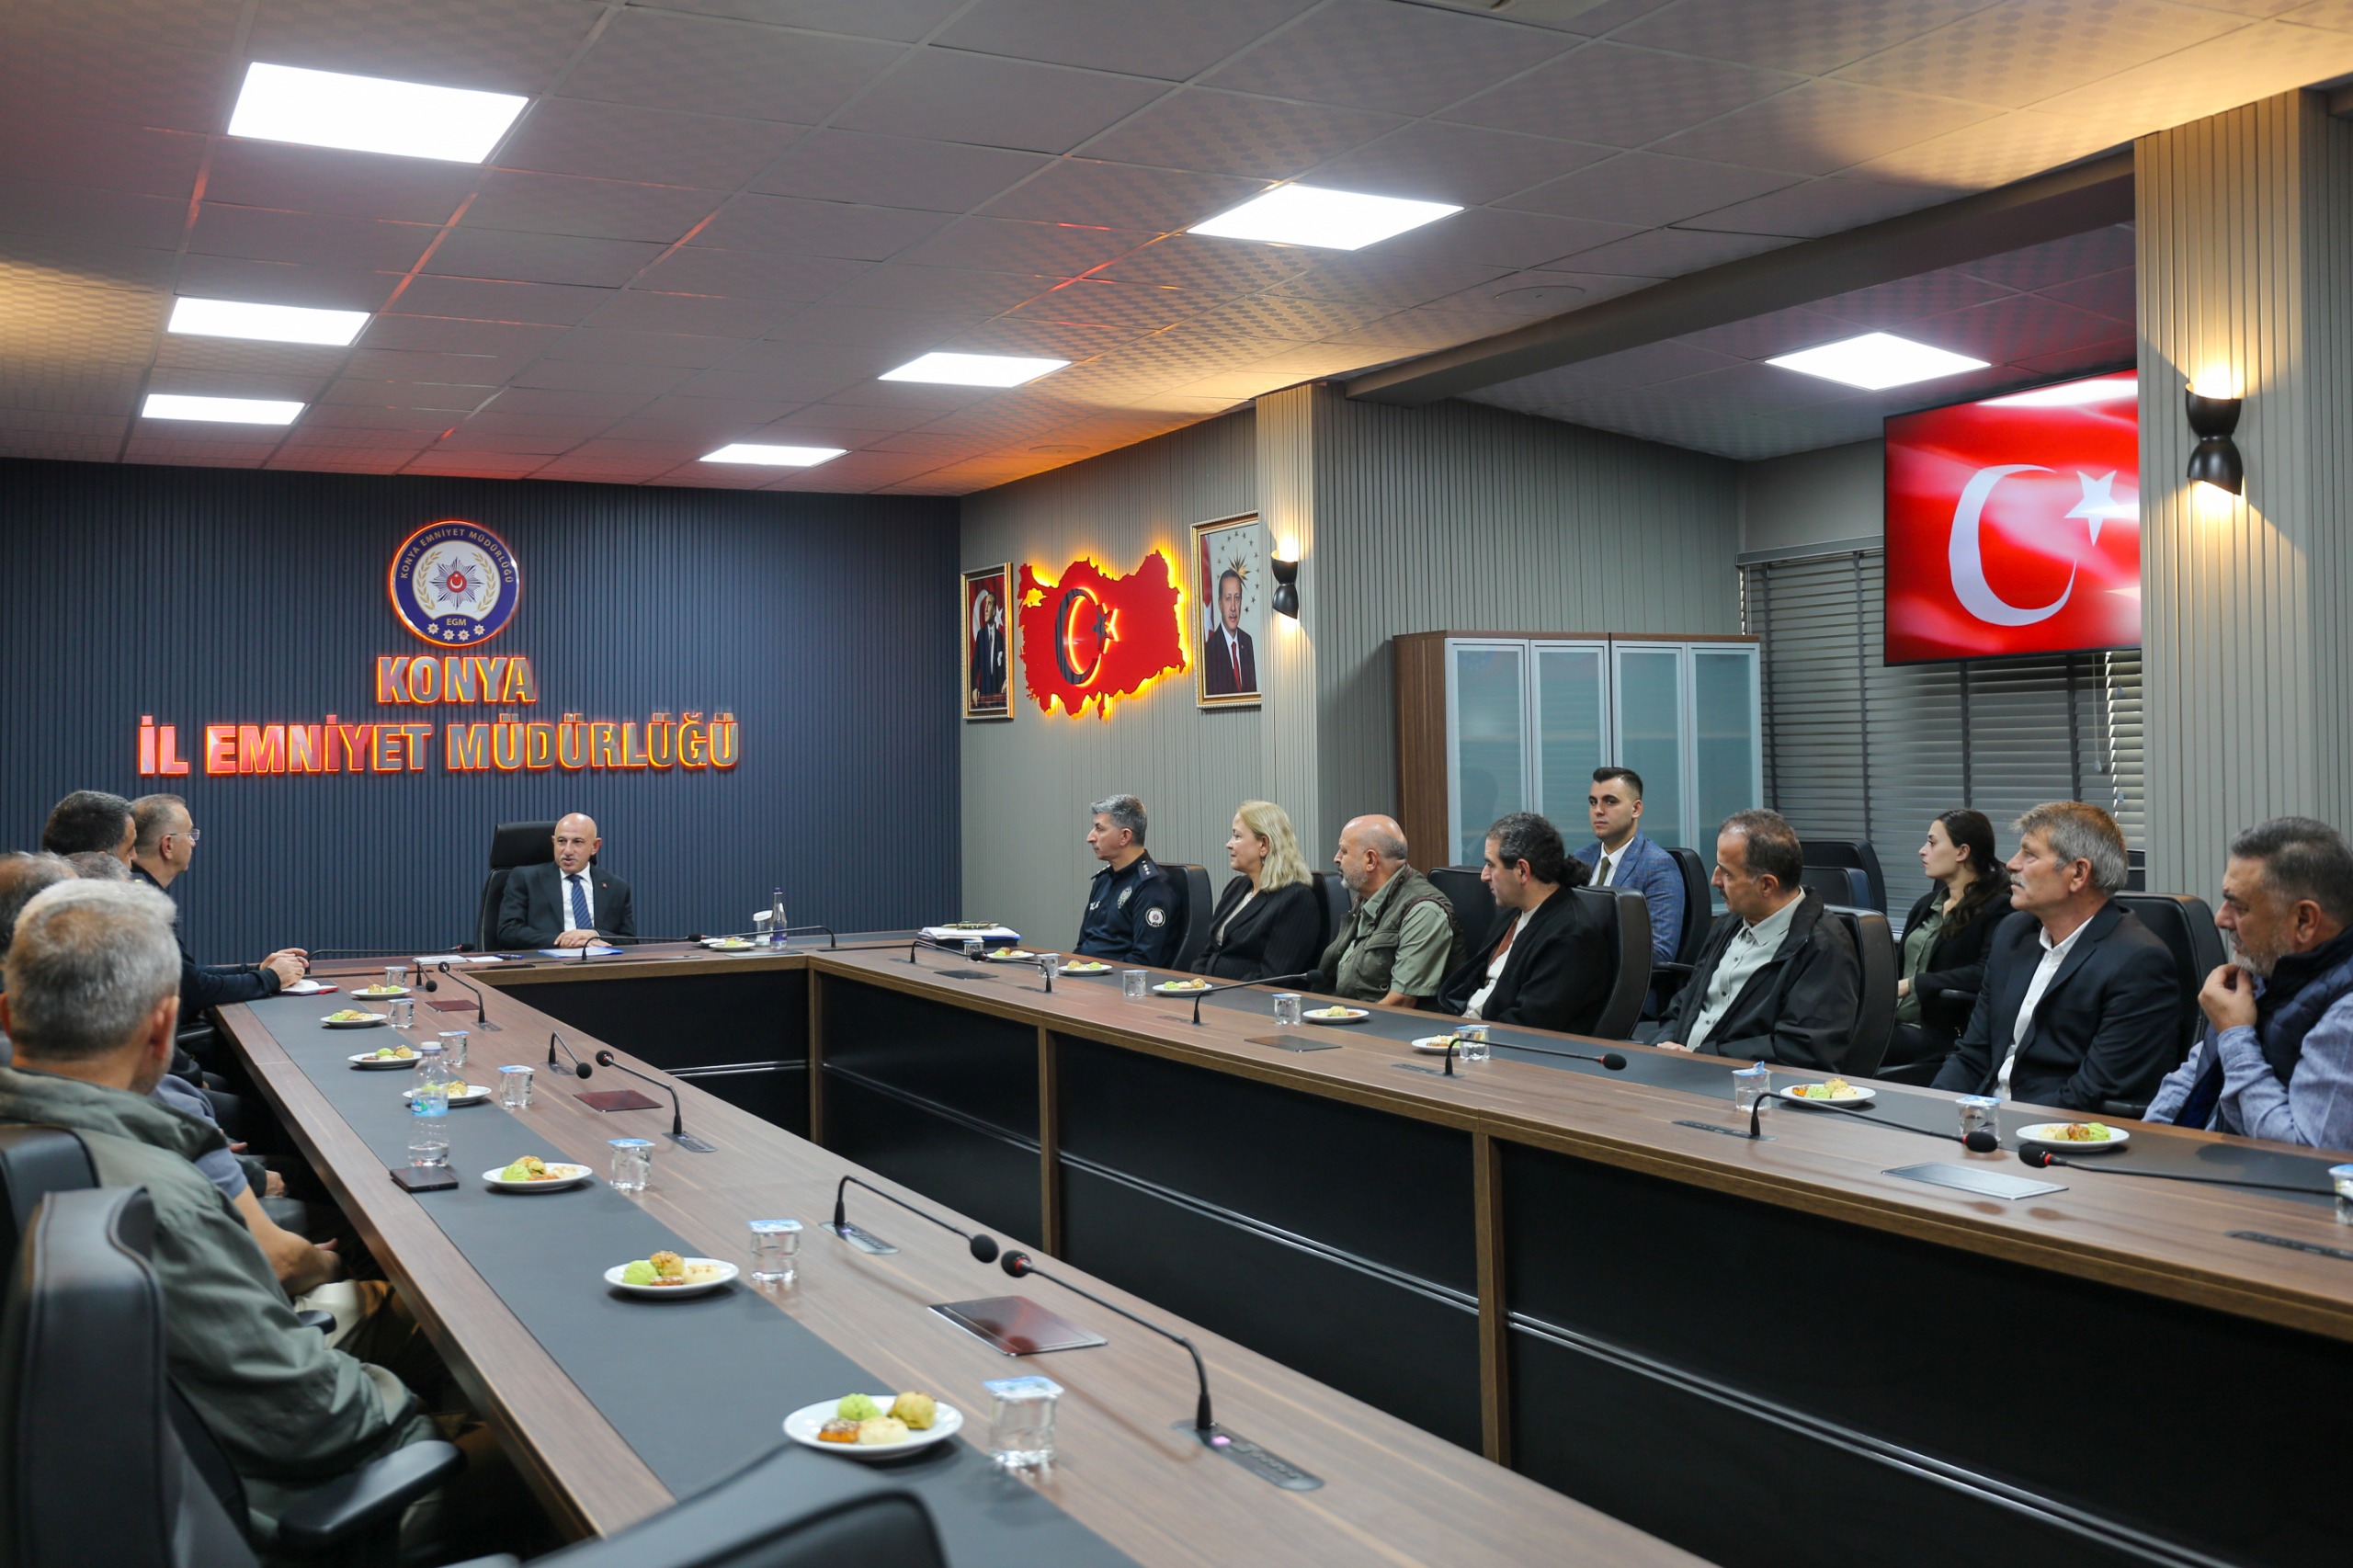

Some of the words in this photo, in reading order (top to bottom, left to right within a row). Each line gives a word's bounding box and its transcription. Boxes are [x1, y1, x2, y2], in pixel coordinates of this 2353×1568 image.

[400, 546, 421, 579] KONYA
[420, 528, 466, 547] EMNİYET
[468, 530, 514, 584] MÜDÜRLÜĞÜ
[446, 618, 467, 626] EGM
[377, 655, 537, 704] KONYA
[139, 714, 189, 775] İL
[206, 714, 433, 774] EMNİYET
[446, 712, 740, 770] MÜDÜRLÜĞÜ
